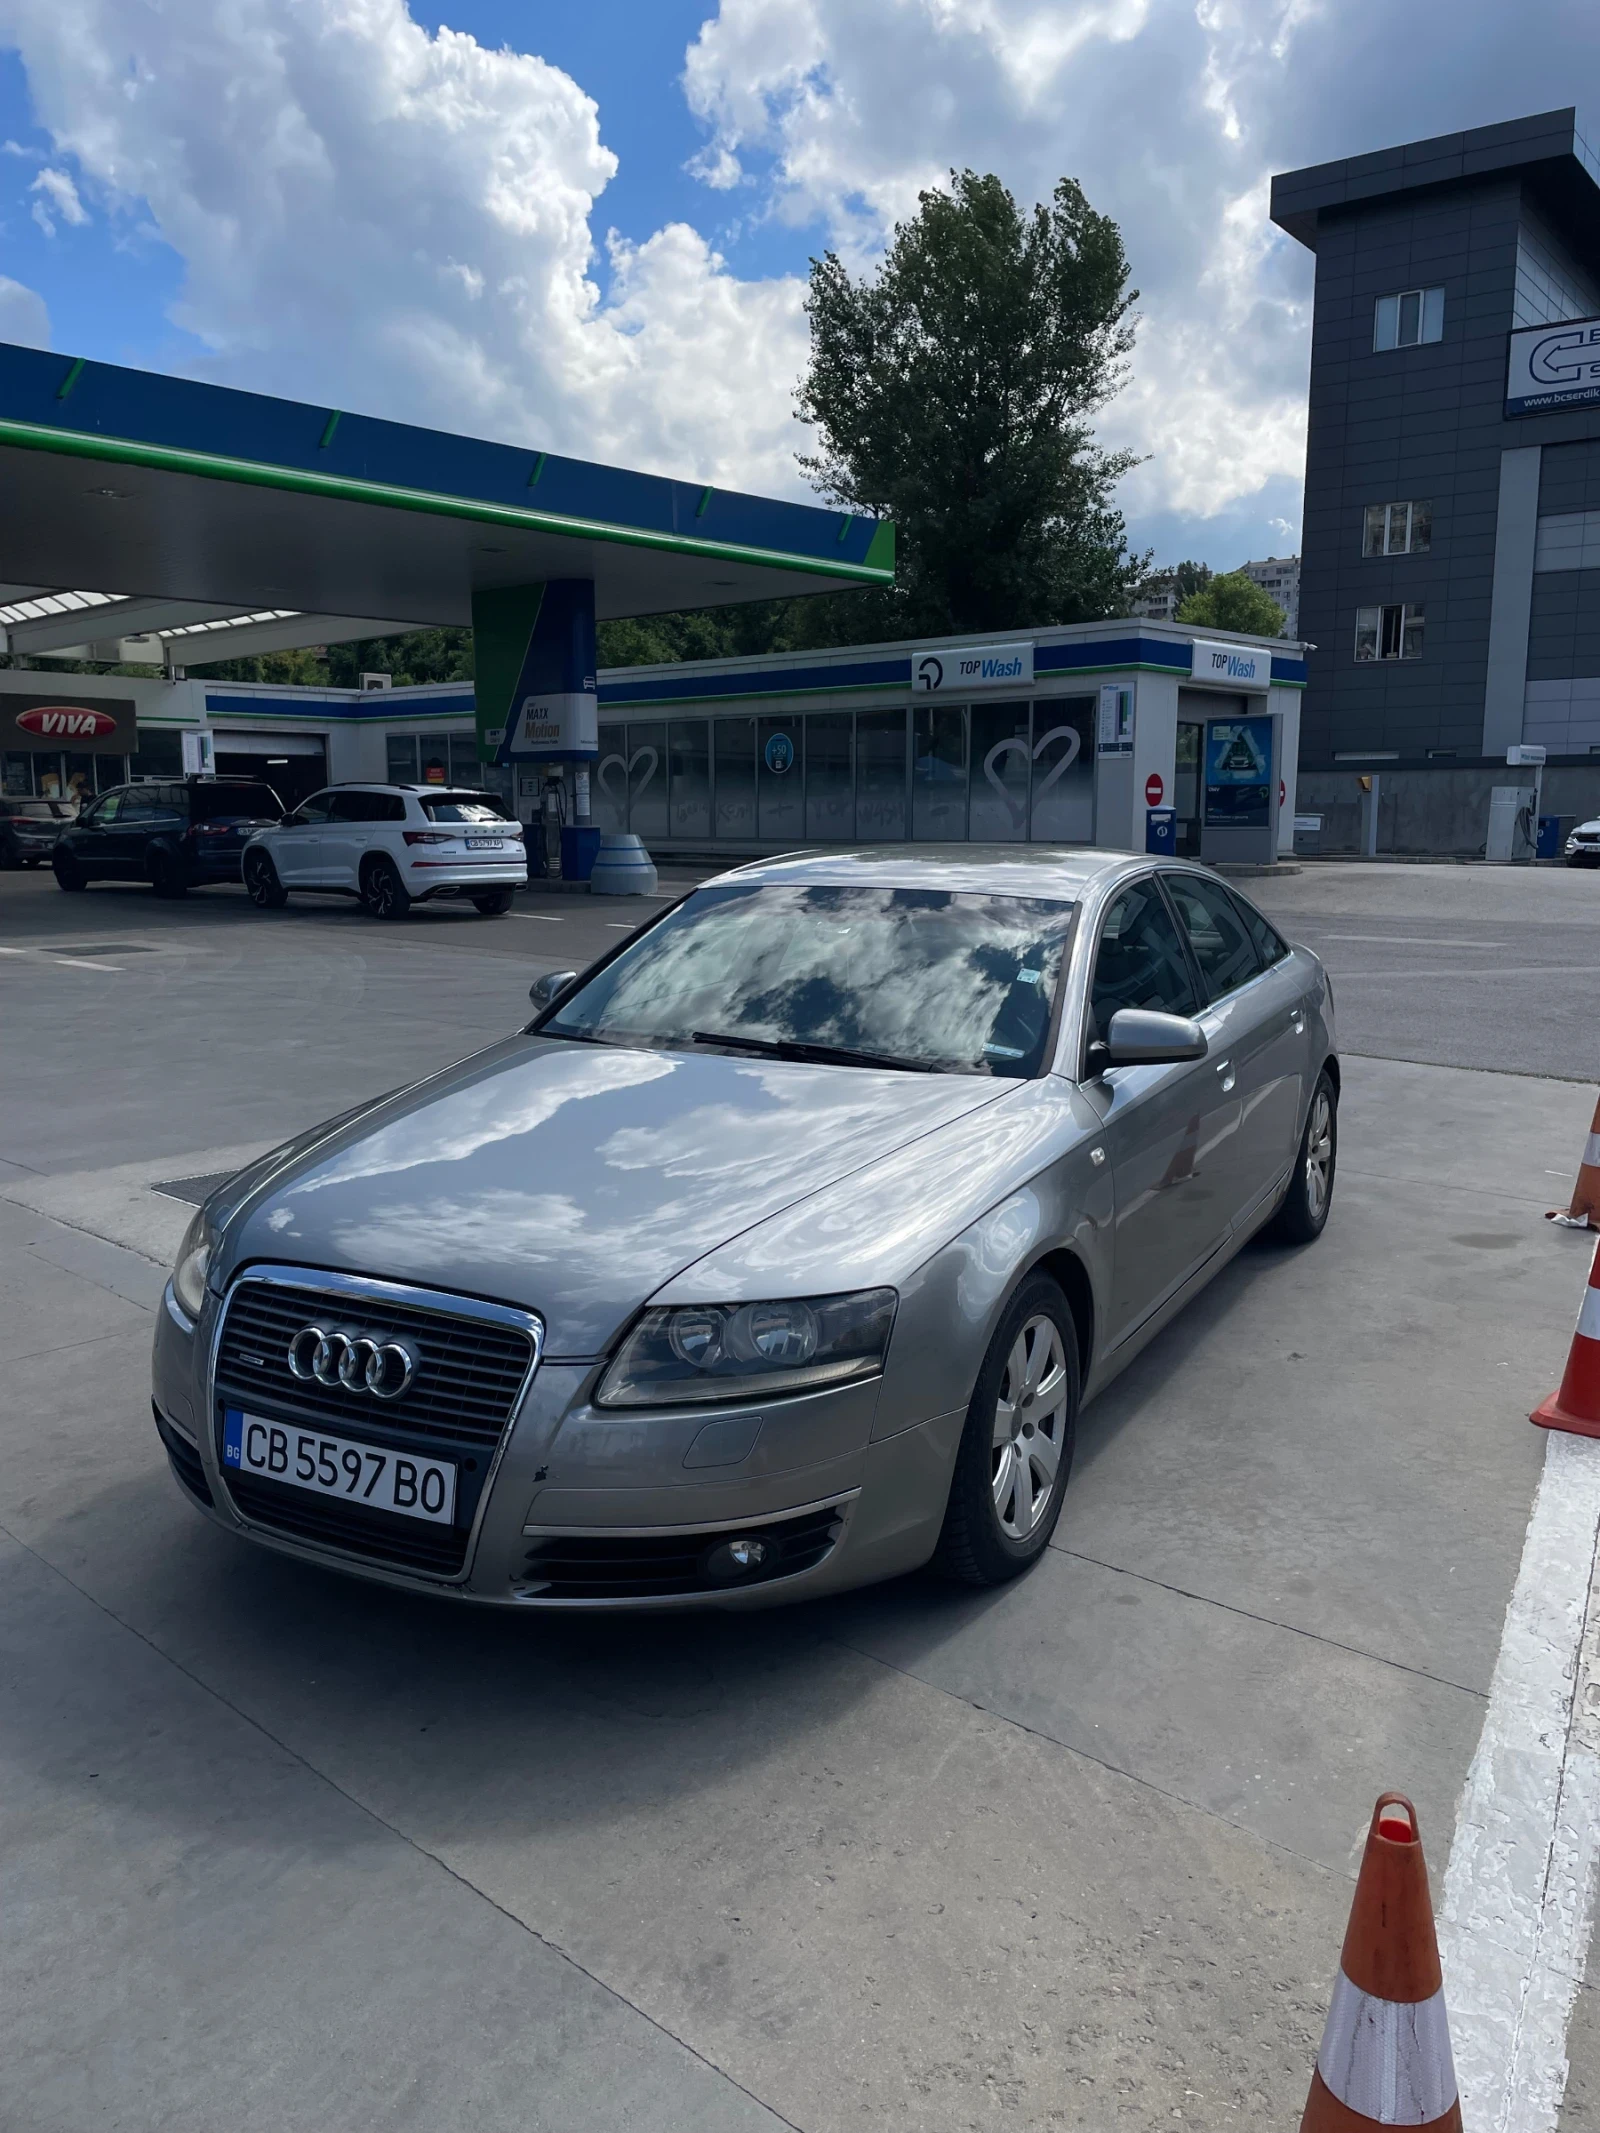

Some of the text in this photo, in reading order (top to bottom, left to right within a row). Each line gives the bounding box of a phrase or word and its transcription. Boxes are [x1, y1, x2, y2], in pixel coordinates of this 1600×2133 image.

[527, 708, 549, 720] MAXX
[42, 713, 97, 734] VIVA
[525, 721, 560, 738] Motion
[227, 1445, 240, 1459] BG
[246, 1424, 445, 1514] CB 5597 BO
